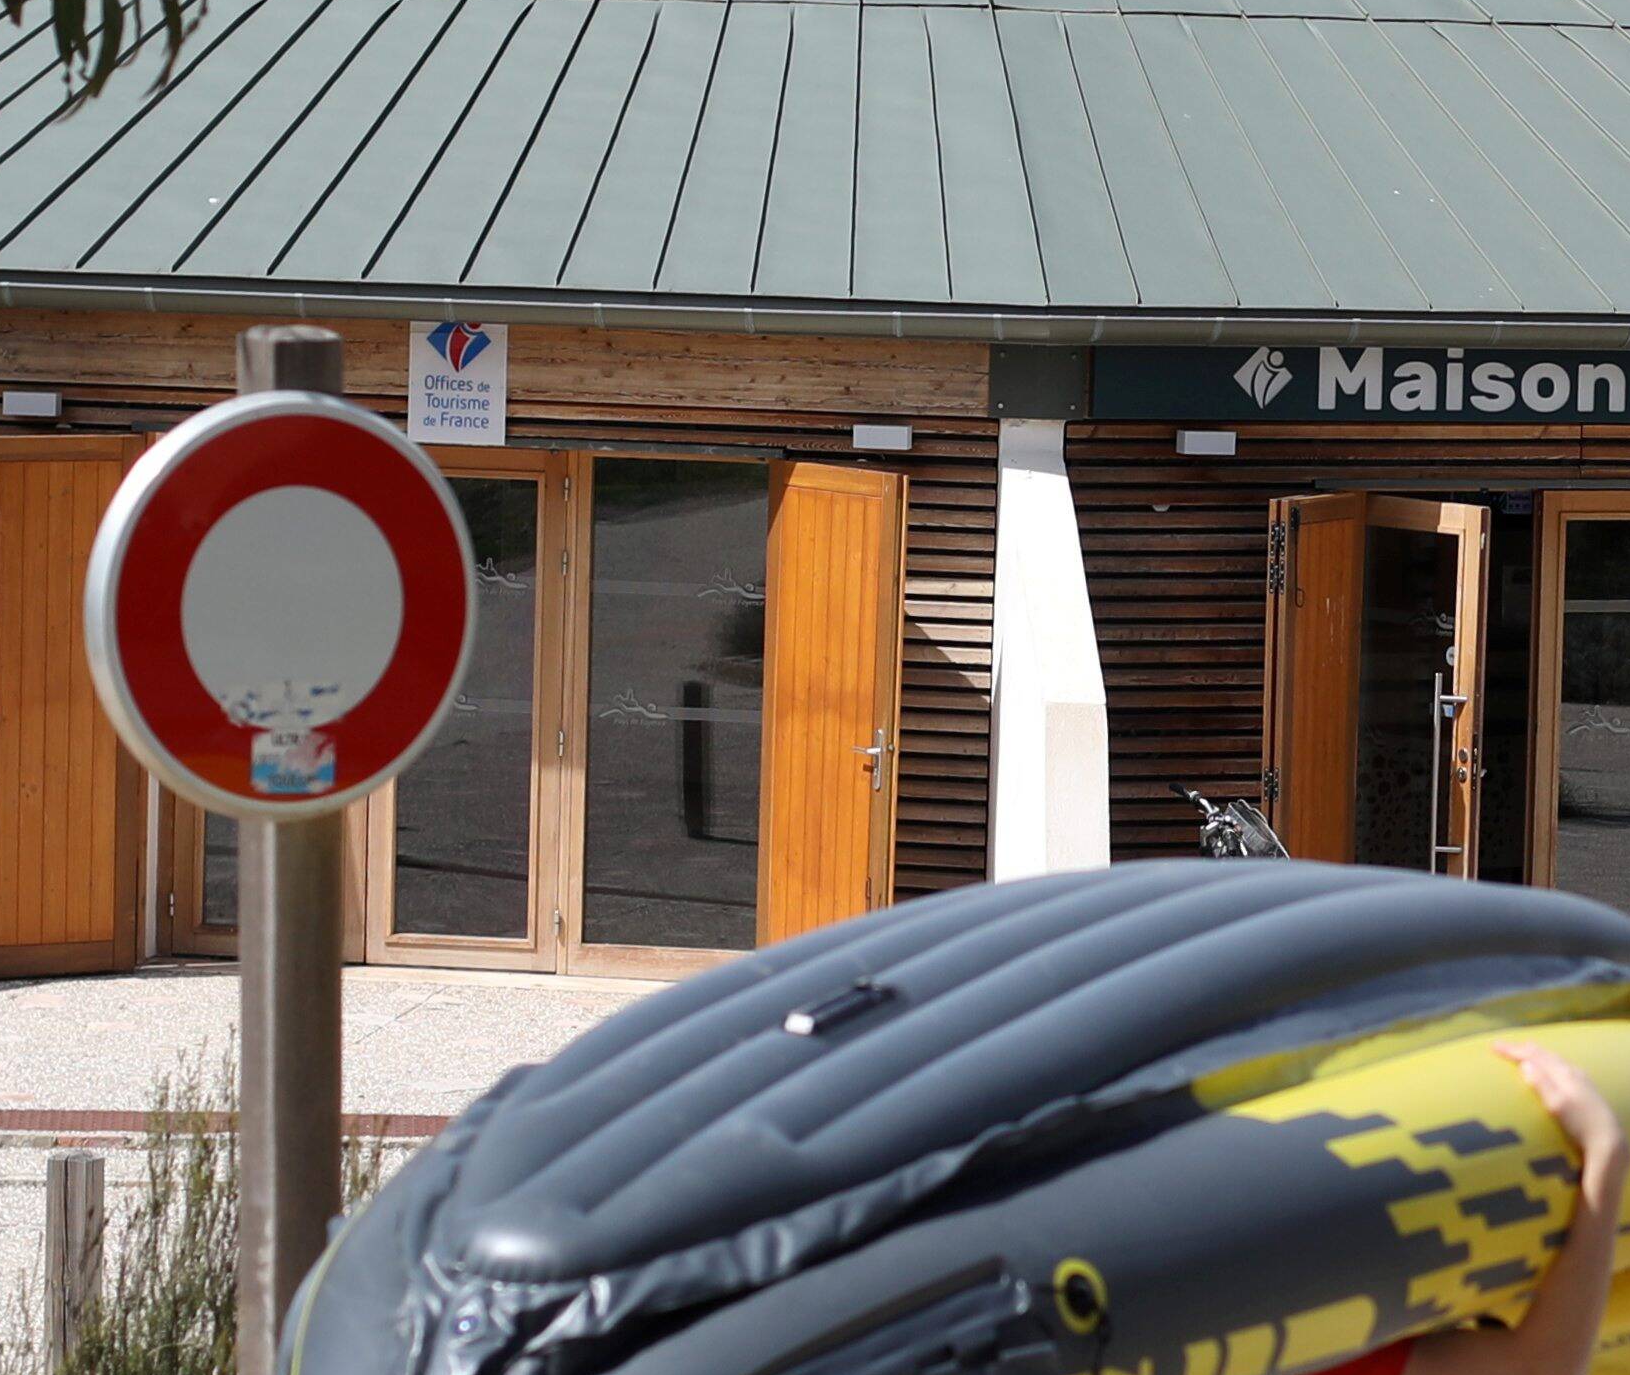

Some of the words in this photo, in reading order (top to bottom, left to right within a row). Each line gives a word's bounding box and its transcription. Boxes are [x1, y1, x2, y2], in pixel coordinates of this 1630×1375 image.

[424, 374, 474, 392] Offices
[477, 382, 490, 393] de
[1318, 347, 1627, 412] Maison
[424, 392, 491, 411] Tourisme
[423, 415, 437, 427] de
[440, 412, 490, 429] France
